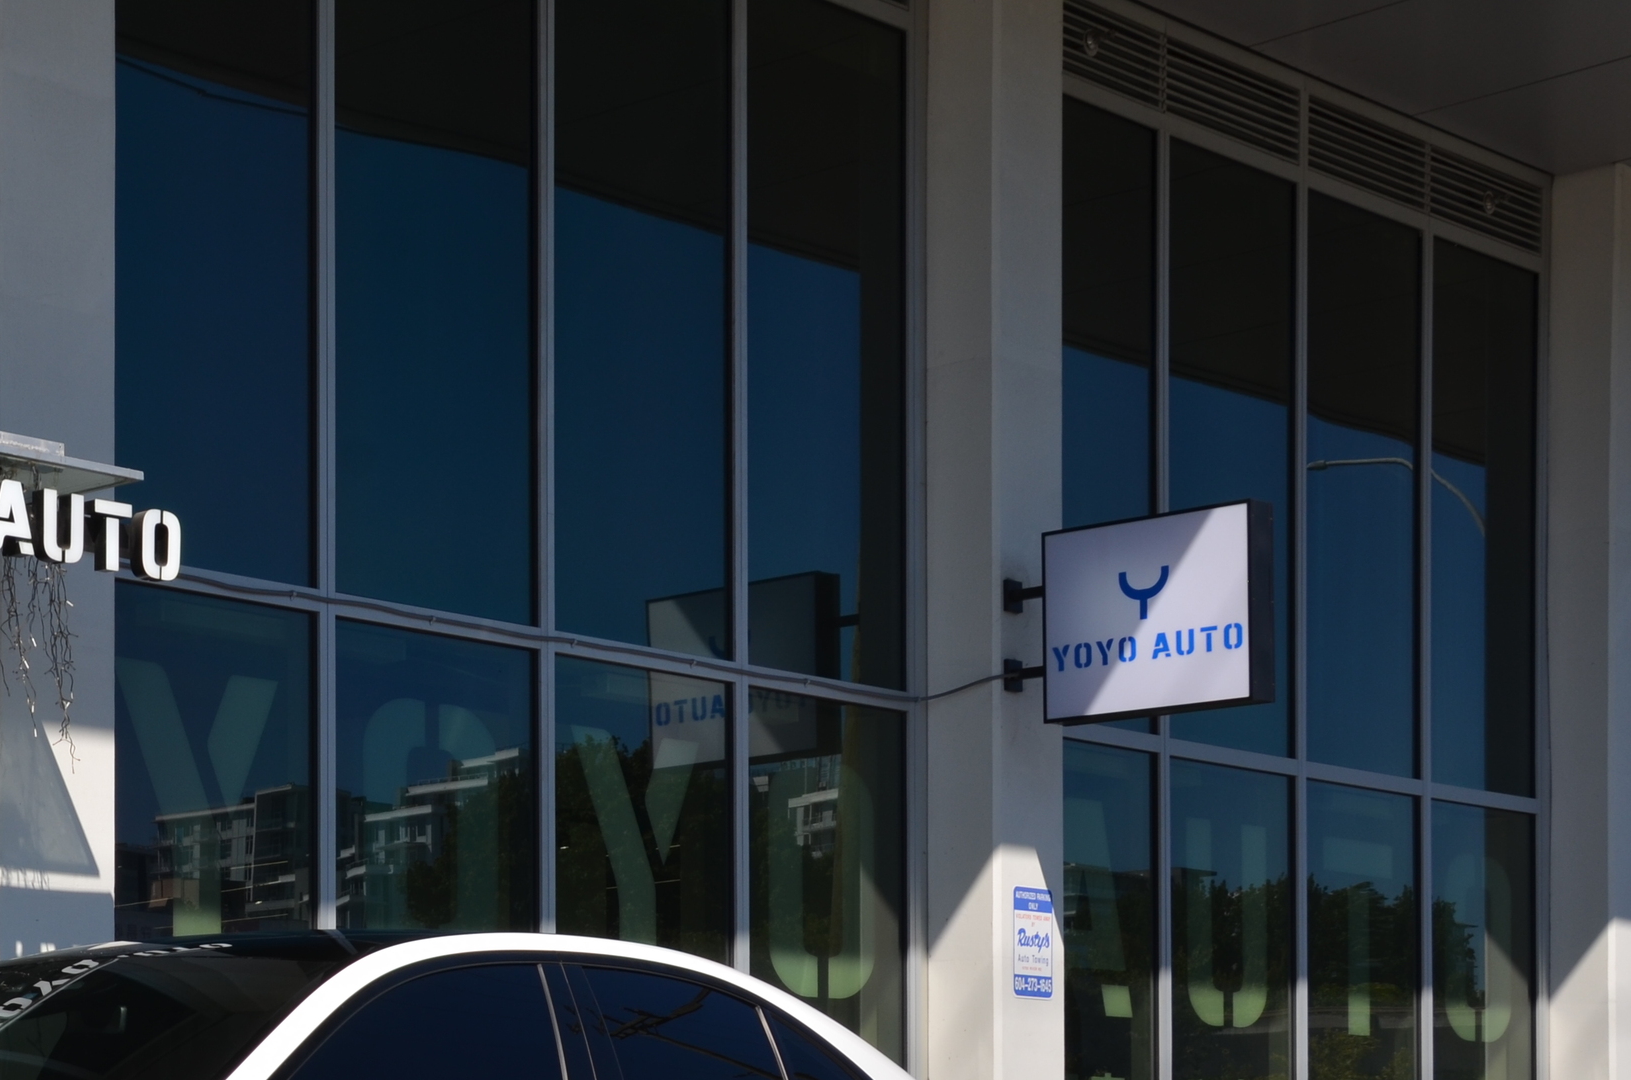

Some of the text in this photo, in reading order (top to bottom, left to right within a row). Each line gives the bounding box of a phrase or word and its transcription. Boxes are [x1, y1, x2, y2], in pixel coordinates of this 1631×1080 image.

[1052, 623, 1244, 672] YOYO AUTO
[1017, 927, 1050, 953] Rusty's
[1018, 954, 1049, 966] Auto Towing
